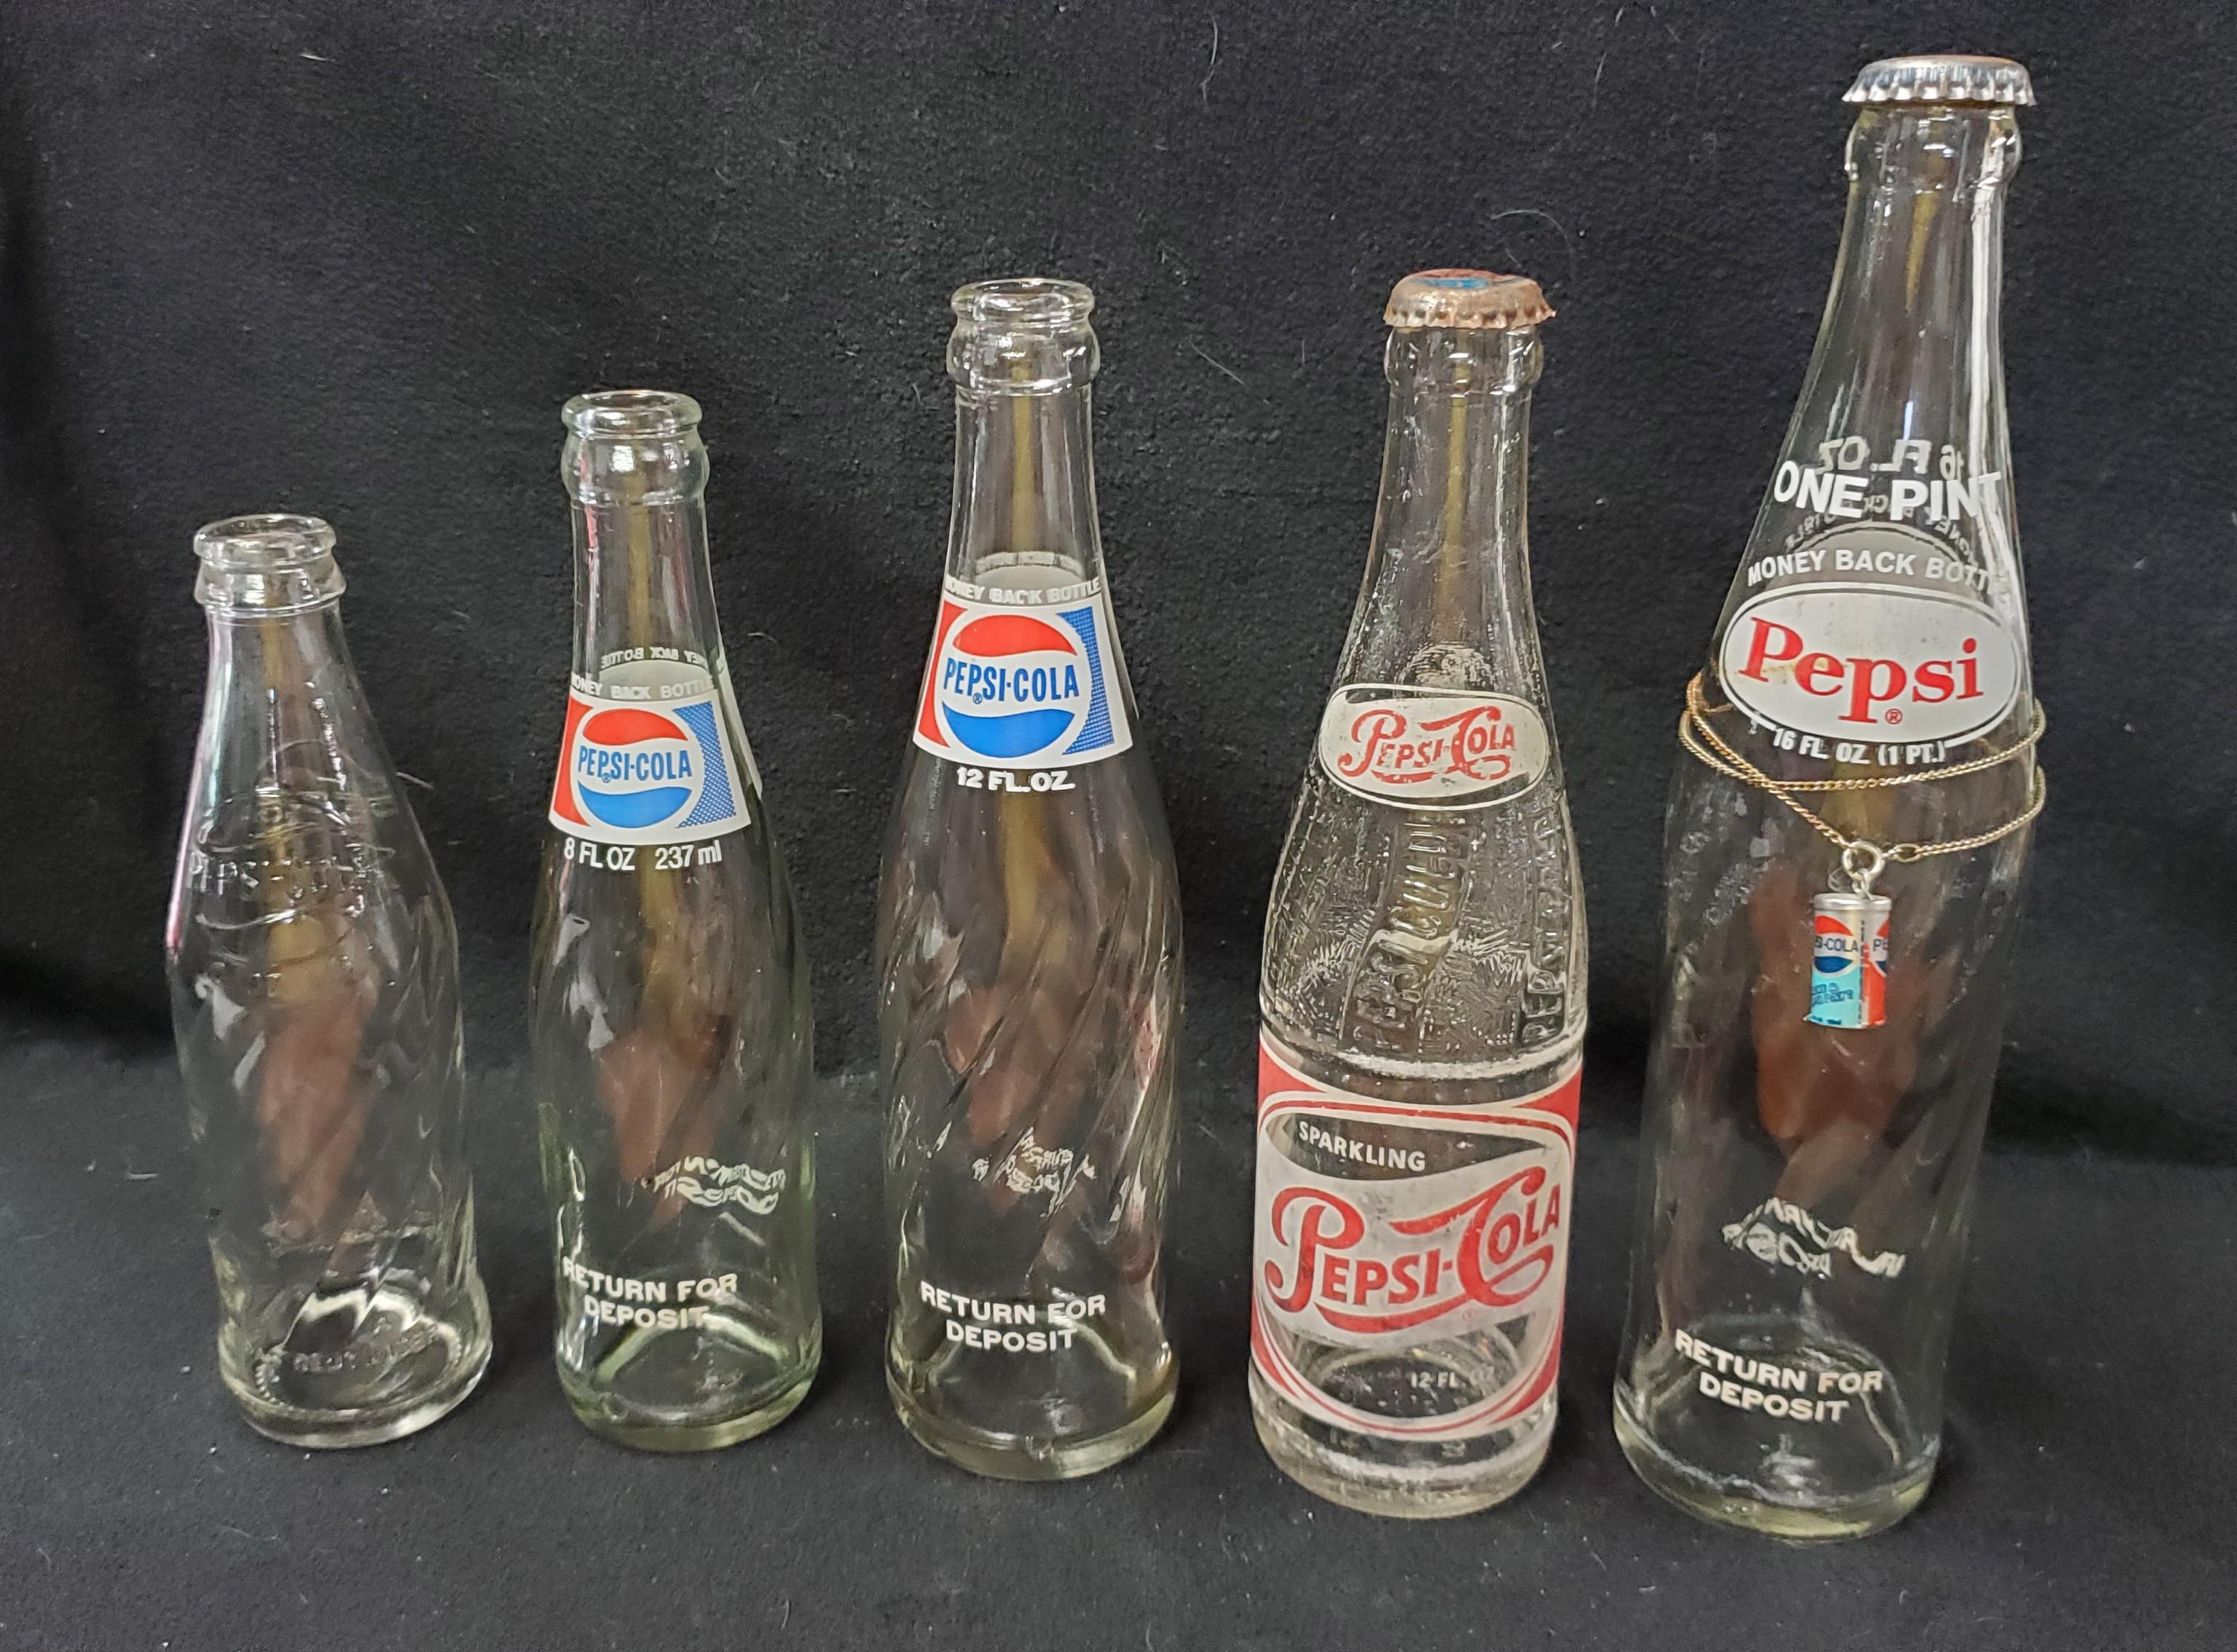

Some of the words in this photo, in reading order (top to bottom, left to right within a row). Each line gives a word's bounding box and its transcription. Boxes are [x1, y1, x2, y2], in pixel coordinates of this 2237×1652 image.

[1774, 460, 1868, 519] ONE
[1890, 471, 2002, 521] PINT
[989, 588, 1042, 605] BACK
[1047, 576, 1102, 604] BOTTLE
[1747, 550, 1825, 586] MONEY
[1836, 549, 1916, 575] BACK
[1925, 557, 1997, 594] BOTT
[610, 685, 652, 699] BACK
[943, 657, 1080, 703] PEPSI-COLA
[1739, 617, 1984, 724] Pepsi
[1338, 705, 1517, 784] PEPSI-COLA
[1773, 728, 1796, 750] 16
[578, 745, 693, 782] PEPSI-COLA
[956, 766, 984, 789] 12
[564, 837, 575, 860] 8
[579, 841, 603, 868] FL
[607, 846, 636, 871] OZ
[655, 844, 694, 870] 237
[698, 839, 723, 865] ml
[1299, 1120, 1426, 1172] SPARKLING
[1265, 1166, 1561, 1334] PEPSI-COLA
[562, 1255, 666, 1303] RETURN
[677, 1273, 737, 1302] FOR
[583, 1294, 709, 1329] DEPOSIT
[921, 1280, 1035, 1325] RETURN
[1047, 1294, 1106, 1323] FOR
[945, 1318, 1077, 1353] DEPOSIT
[1674, 1328, 1806, 1393] RETURN
[1817, 1370, 1884, 1393] FOR
[1699, 1372, 1849, 1423] DEPOSIT
